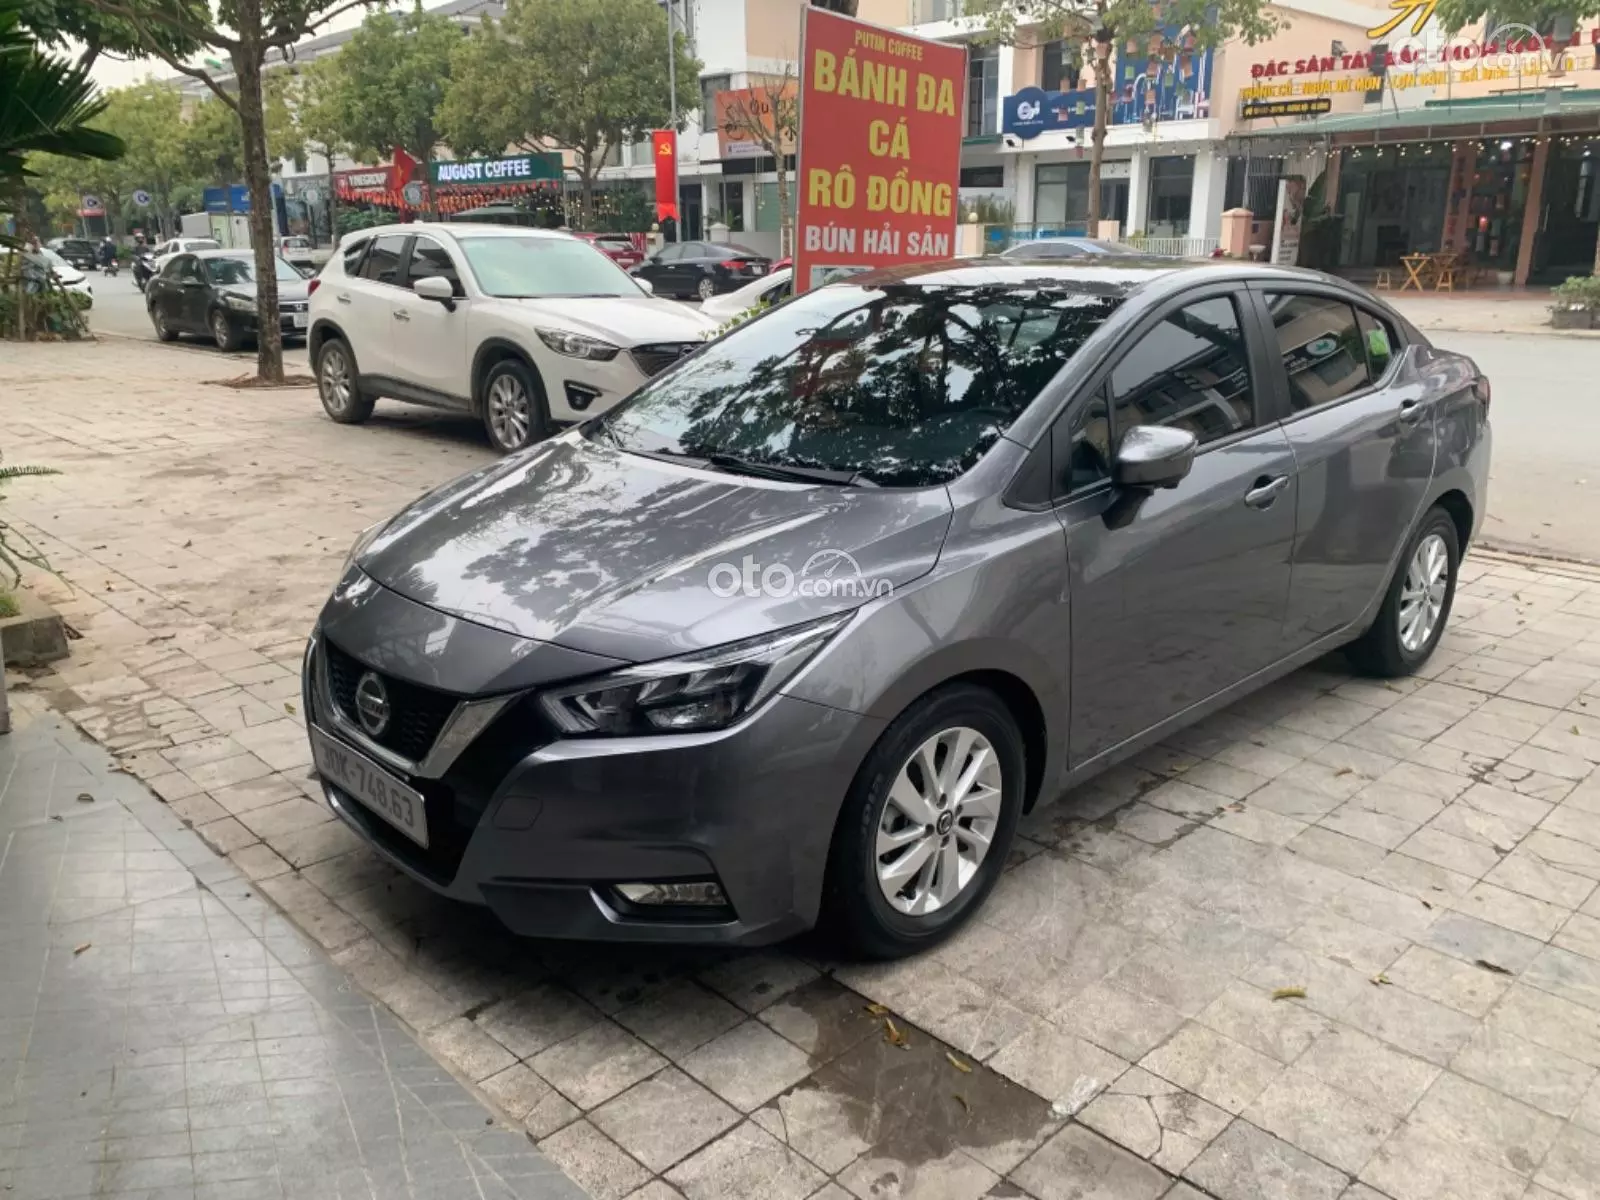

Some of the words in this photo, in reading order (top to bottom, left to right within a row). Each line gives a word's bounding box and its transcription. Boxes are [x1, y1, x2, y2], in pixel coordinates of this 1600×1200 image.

[855, 30, 886, 53] PUTIN
[888, 38, 924, 61] COFFEE
[813, 48, 907, 107] BÁNH
[916, 73, 956, 117] ĐA
[869, 116, 911, 160] CÁ
[437, 162, 483, 181] AUGUST
[808, 164, 856, 209] RÔ
[867, 167, 952, 217] ĐỒNG
[805, 221, 855, 254] BÚN
[863, 222, 900, 255] HẢI
[907, 224, 949, 257] SẢN
